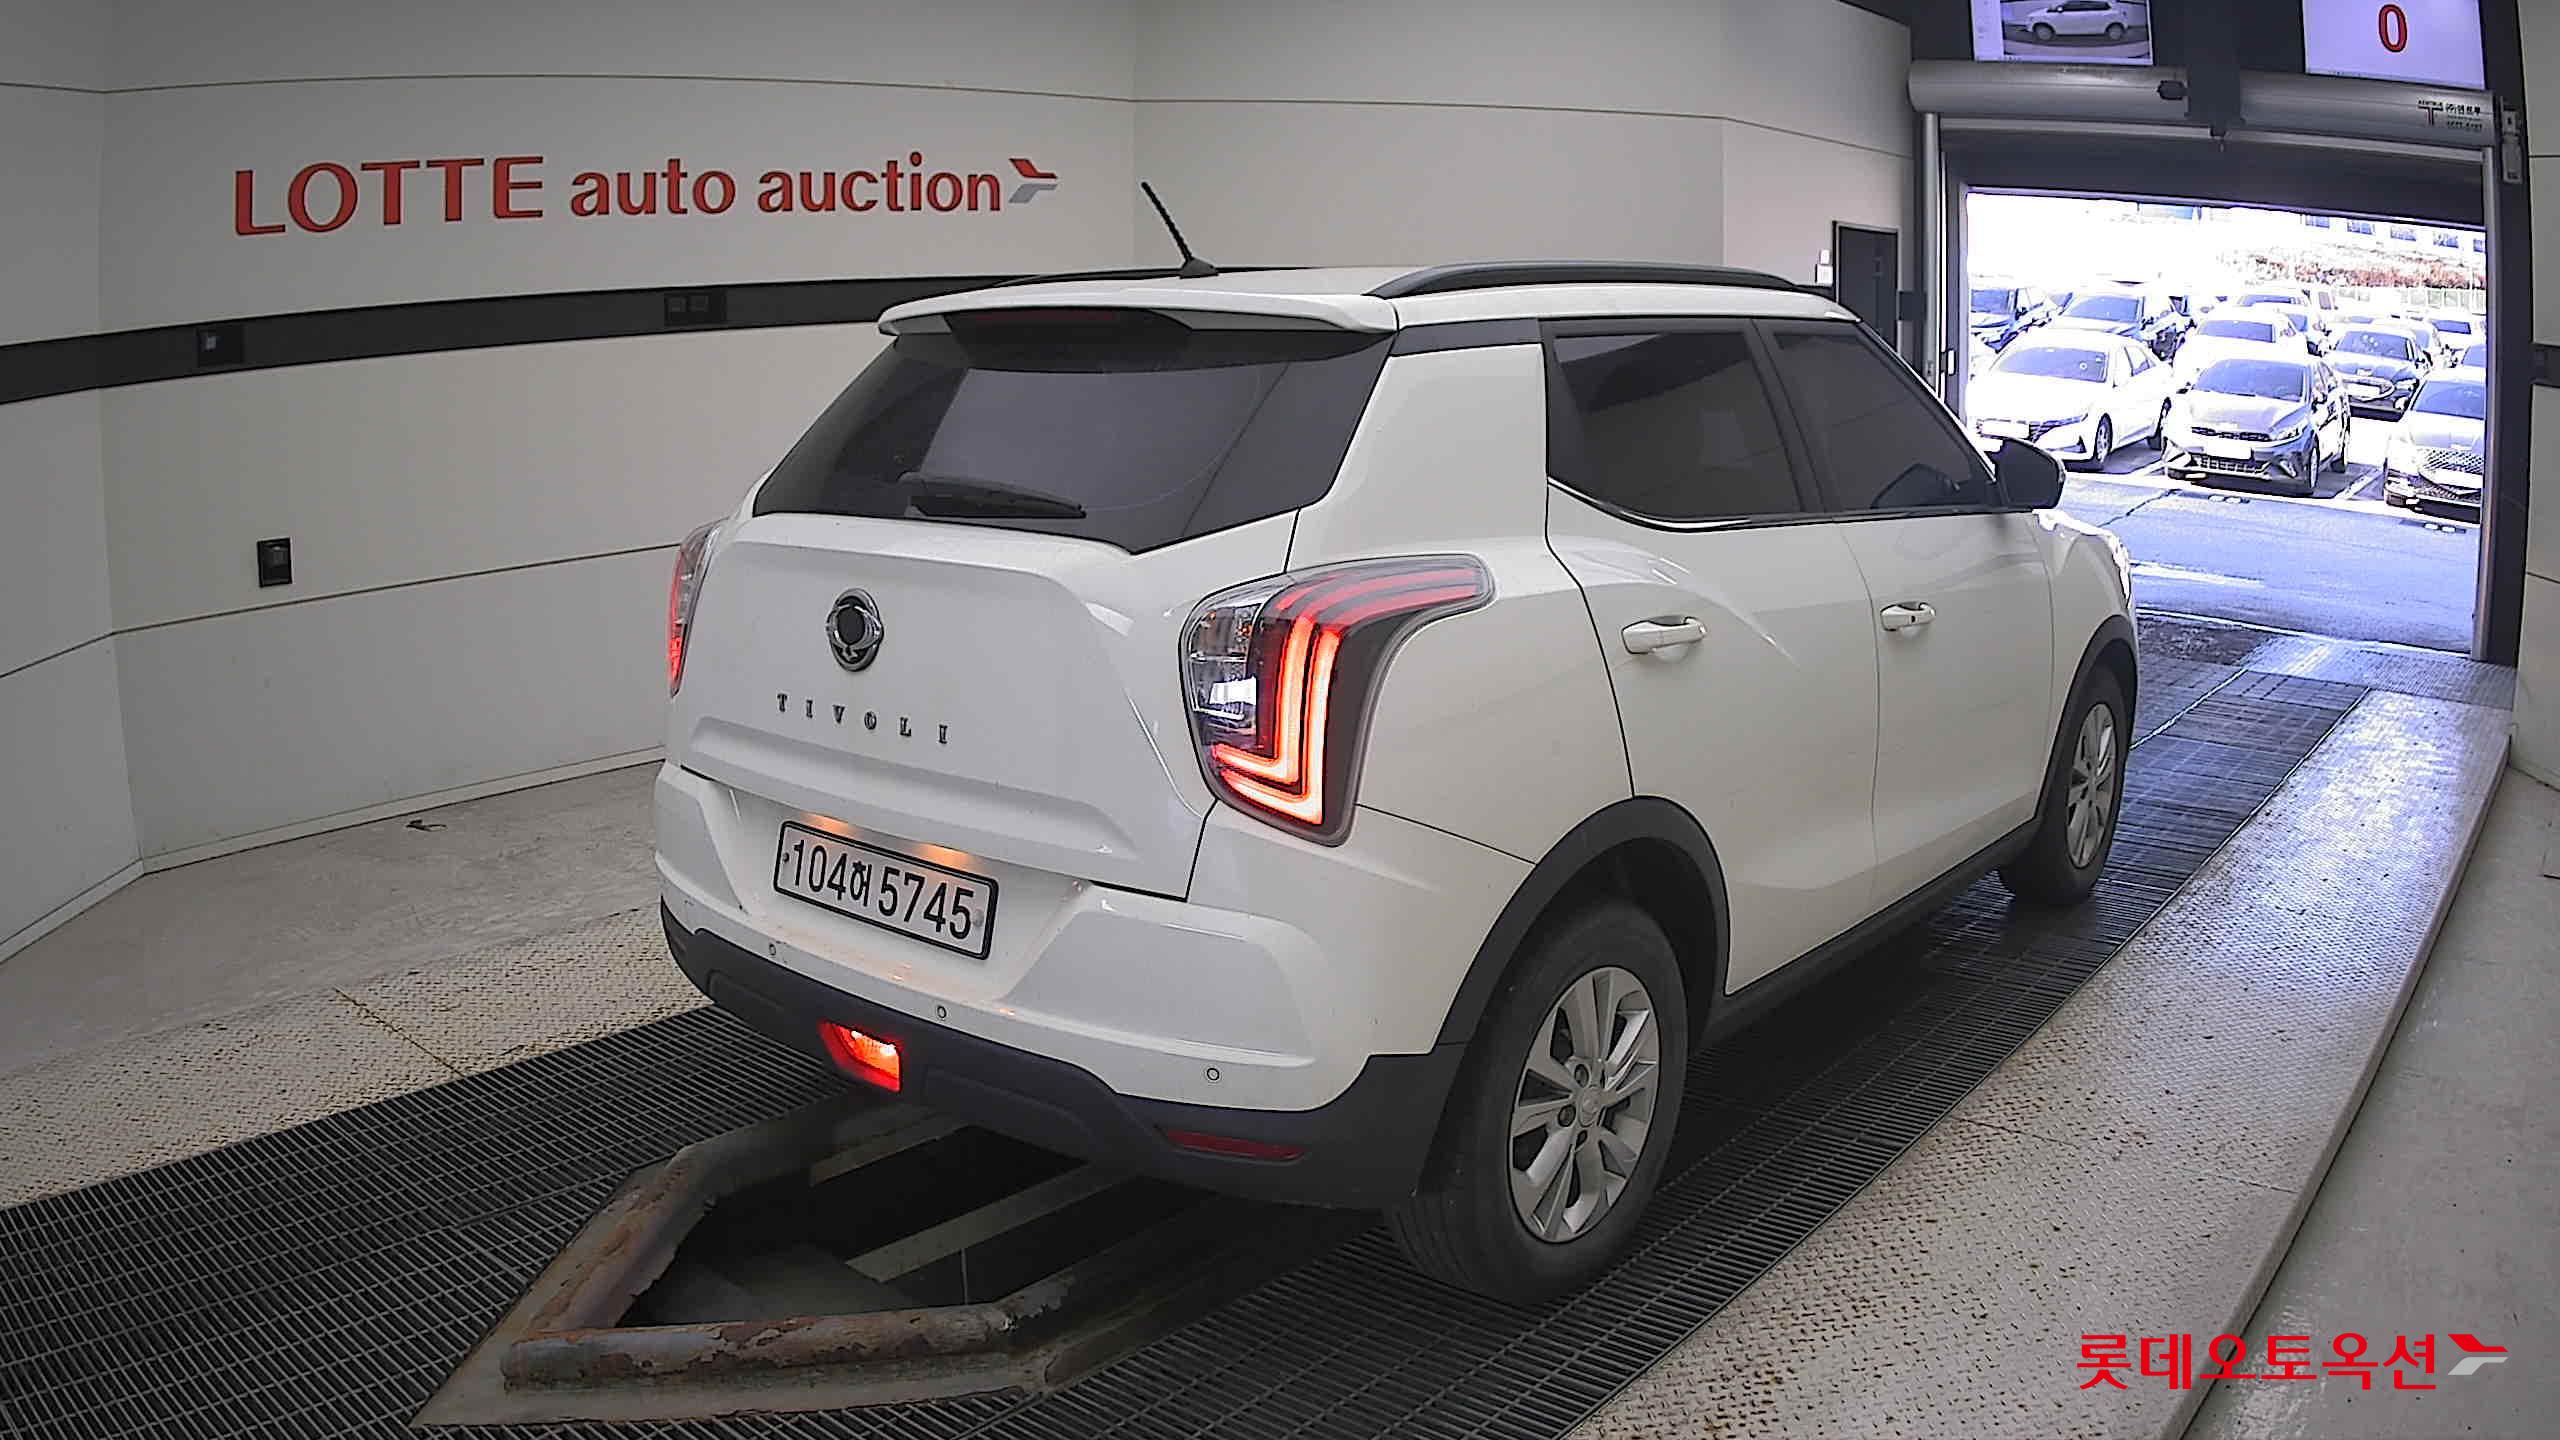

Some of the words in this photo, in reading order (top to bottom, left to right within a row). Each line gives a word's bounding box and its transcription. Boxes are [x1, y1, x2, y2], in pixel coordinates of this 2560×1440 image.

[2378, 3, 2408, 53] 0
[235, 156, 543, 235] LOTTE
[570, 158, 736, 217] auto
[757, 151, 1001, 213] auction
[777, 692, 948, 744] TIVOLI
[878, 865, 975, 939] 5745
